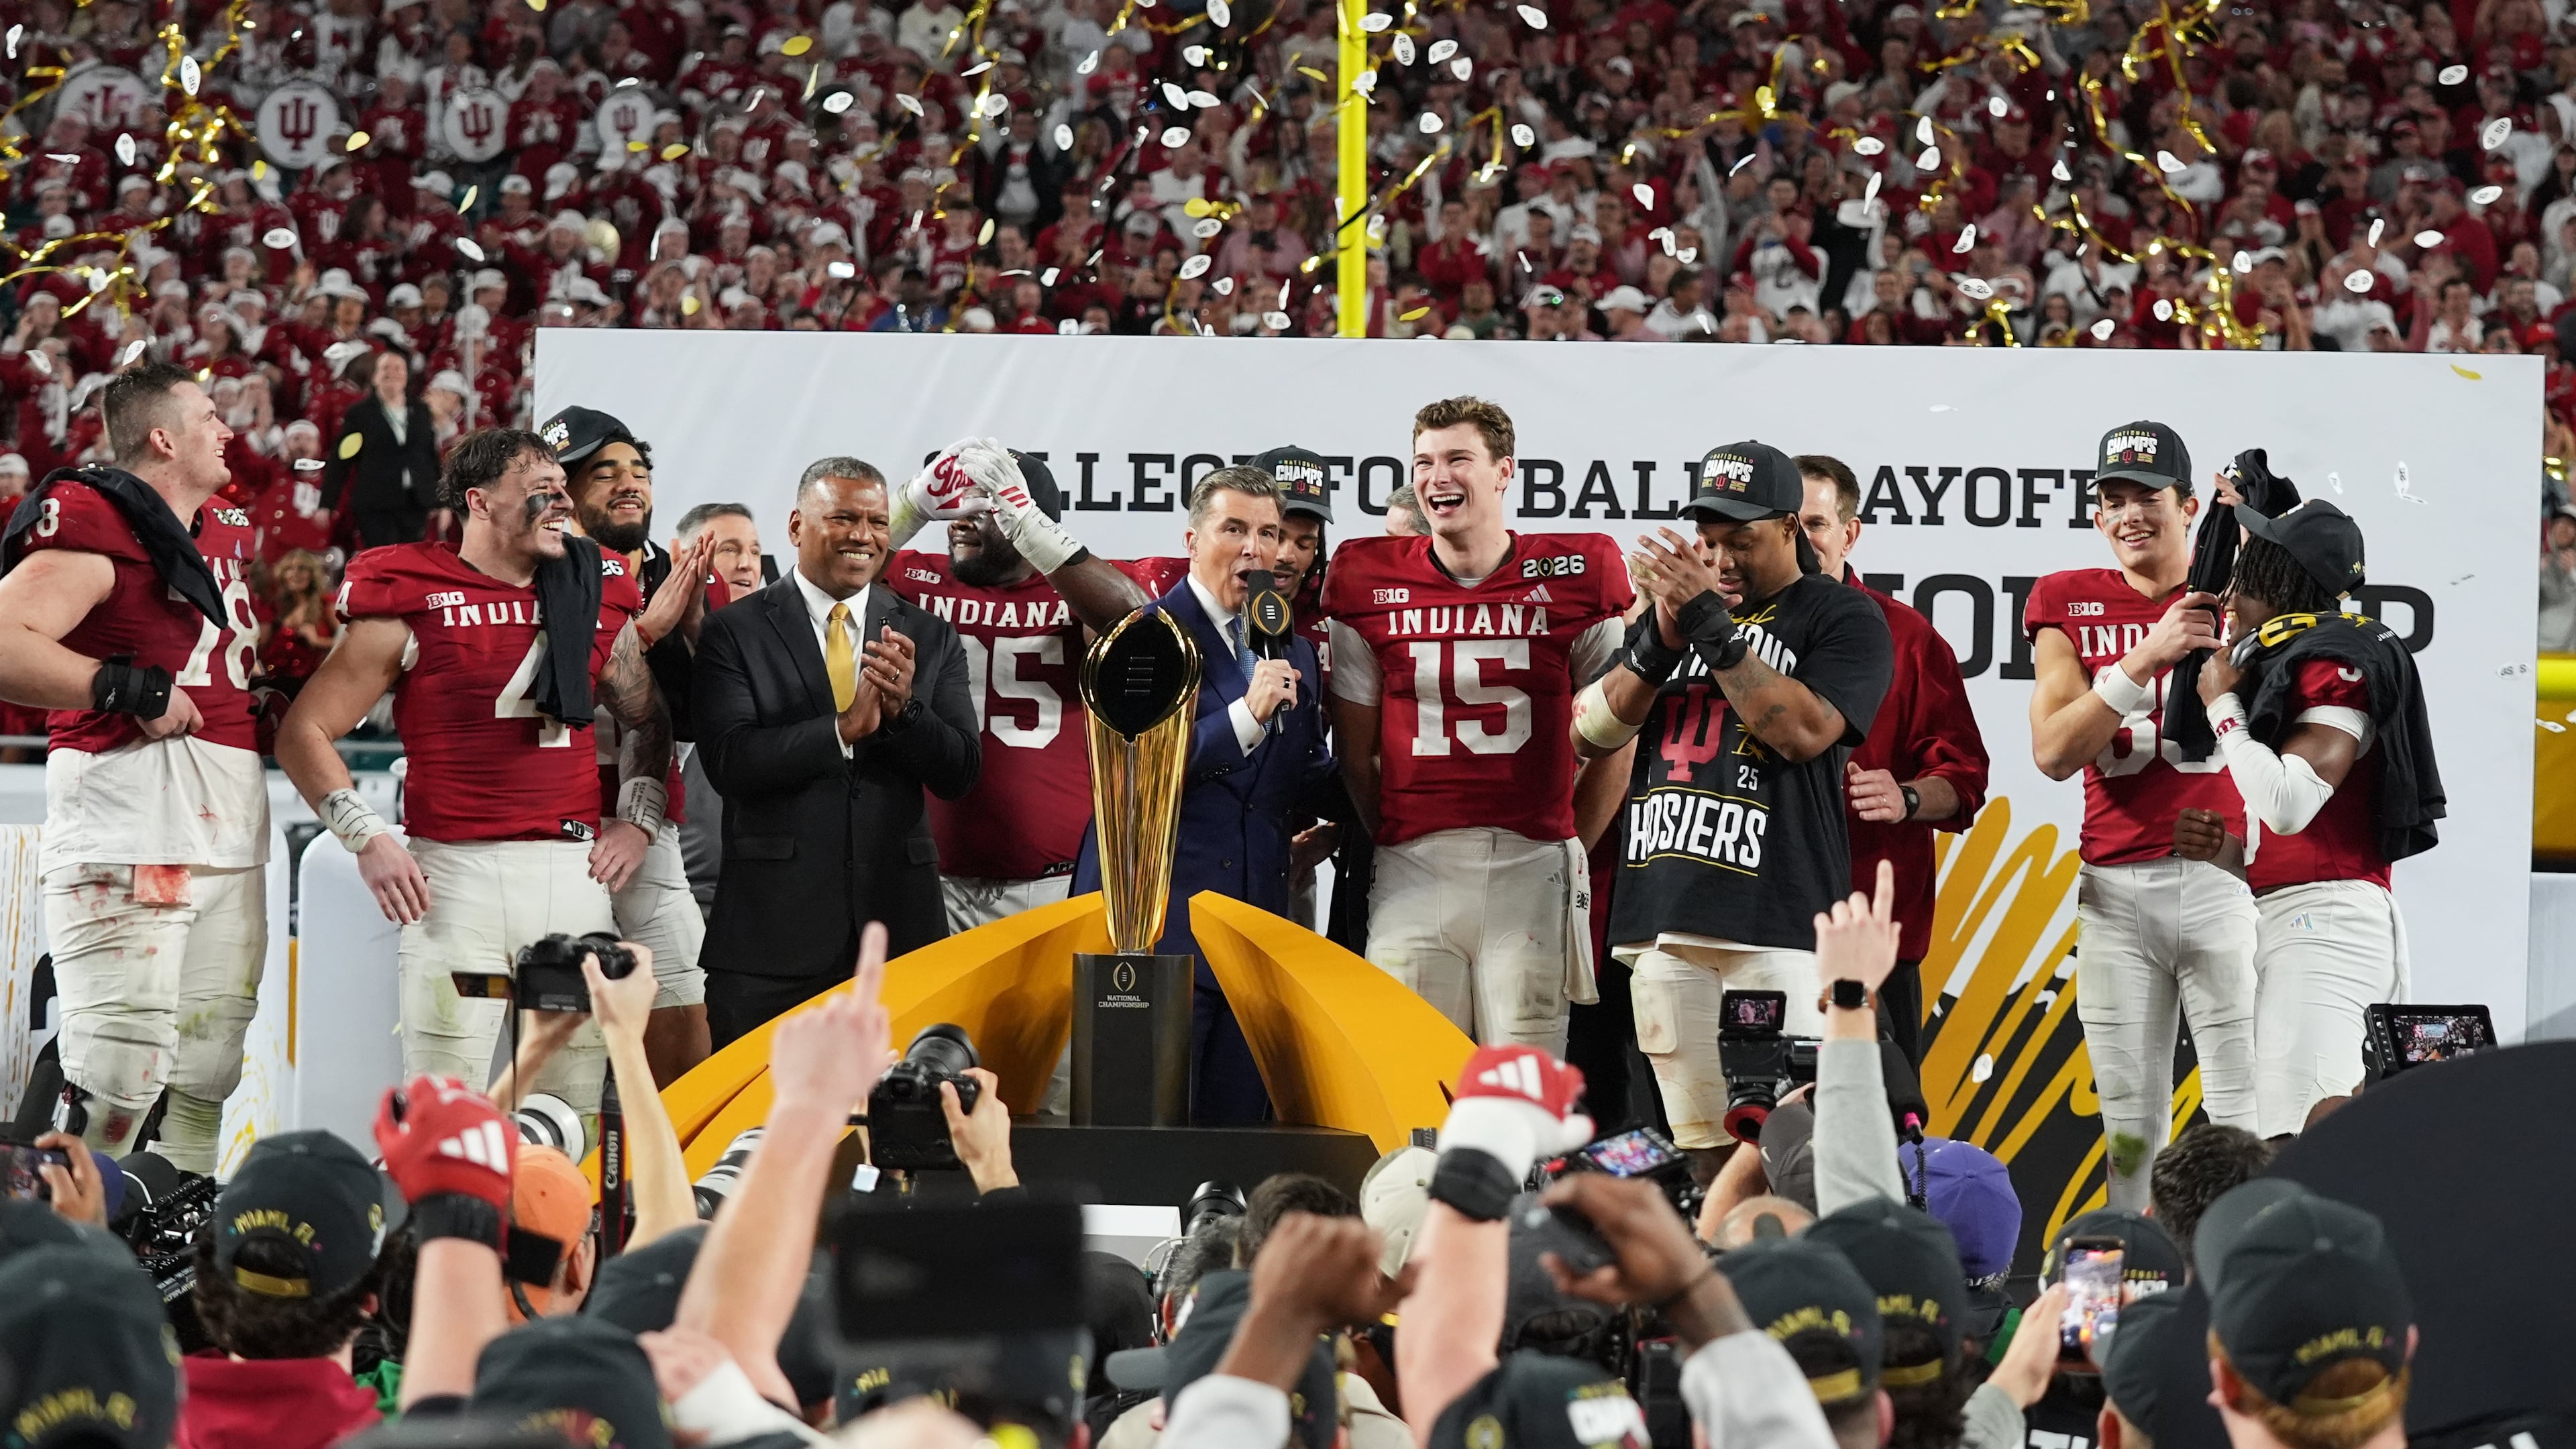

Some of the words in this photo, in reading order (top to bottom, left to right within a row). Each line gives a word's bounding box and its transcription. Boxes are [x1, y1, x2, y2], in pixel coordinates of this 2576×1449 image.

[2106, 435, 2158, 456] CHAMPS
[1275, 464, 1324, 488] CHAMPS
[1703, 459, 1754, 483] CHAMPS
[918, 592, 1073, 628] INDIANA
[1387, 603, 1551, 636] INDIANA
[1409, 638, 1532, 756] 15
[1737, 765, 1758, 791] 25
[606, 1130, 618, 1190] Canon
